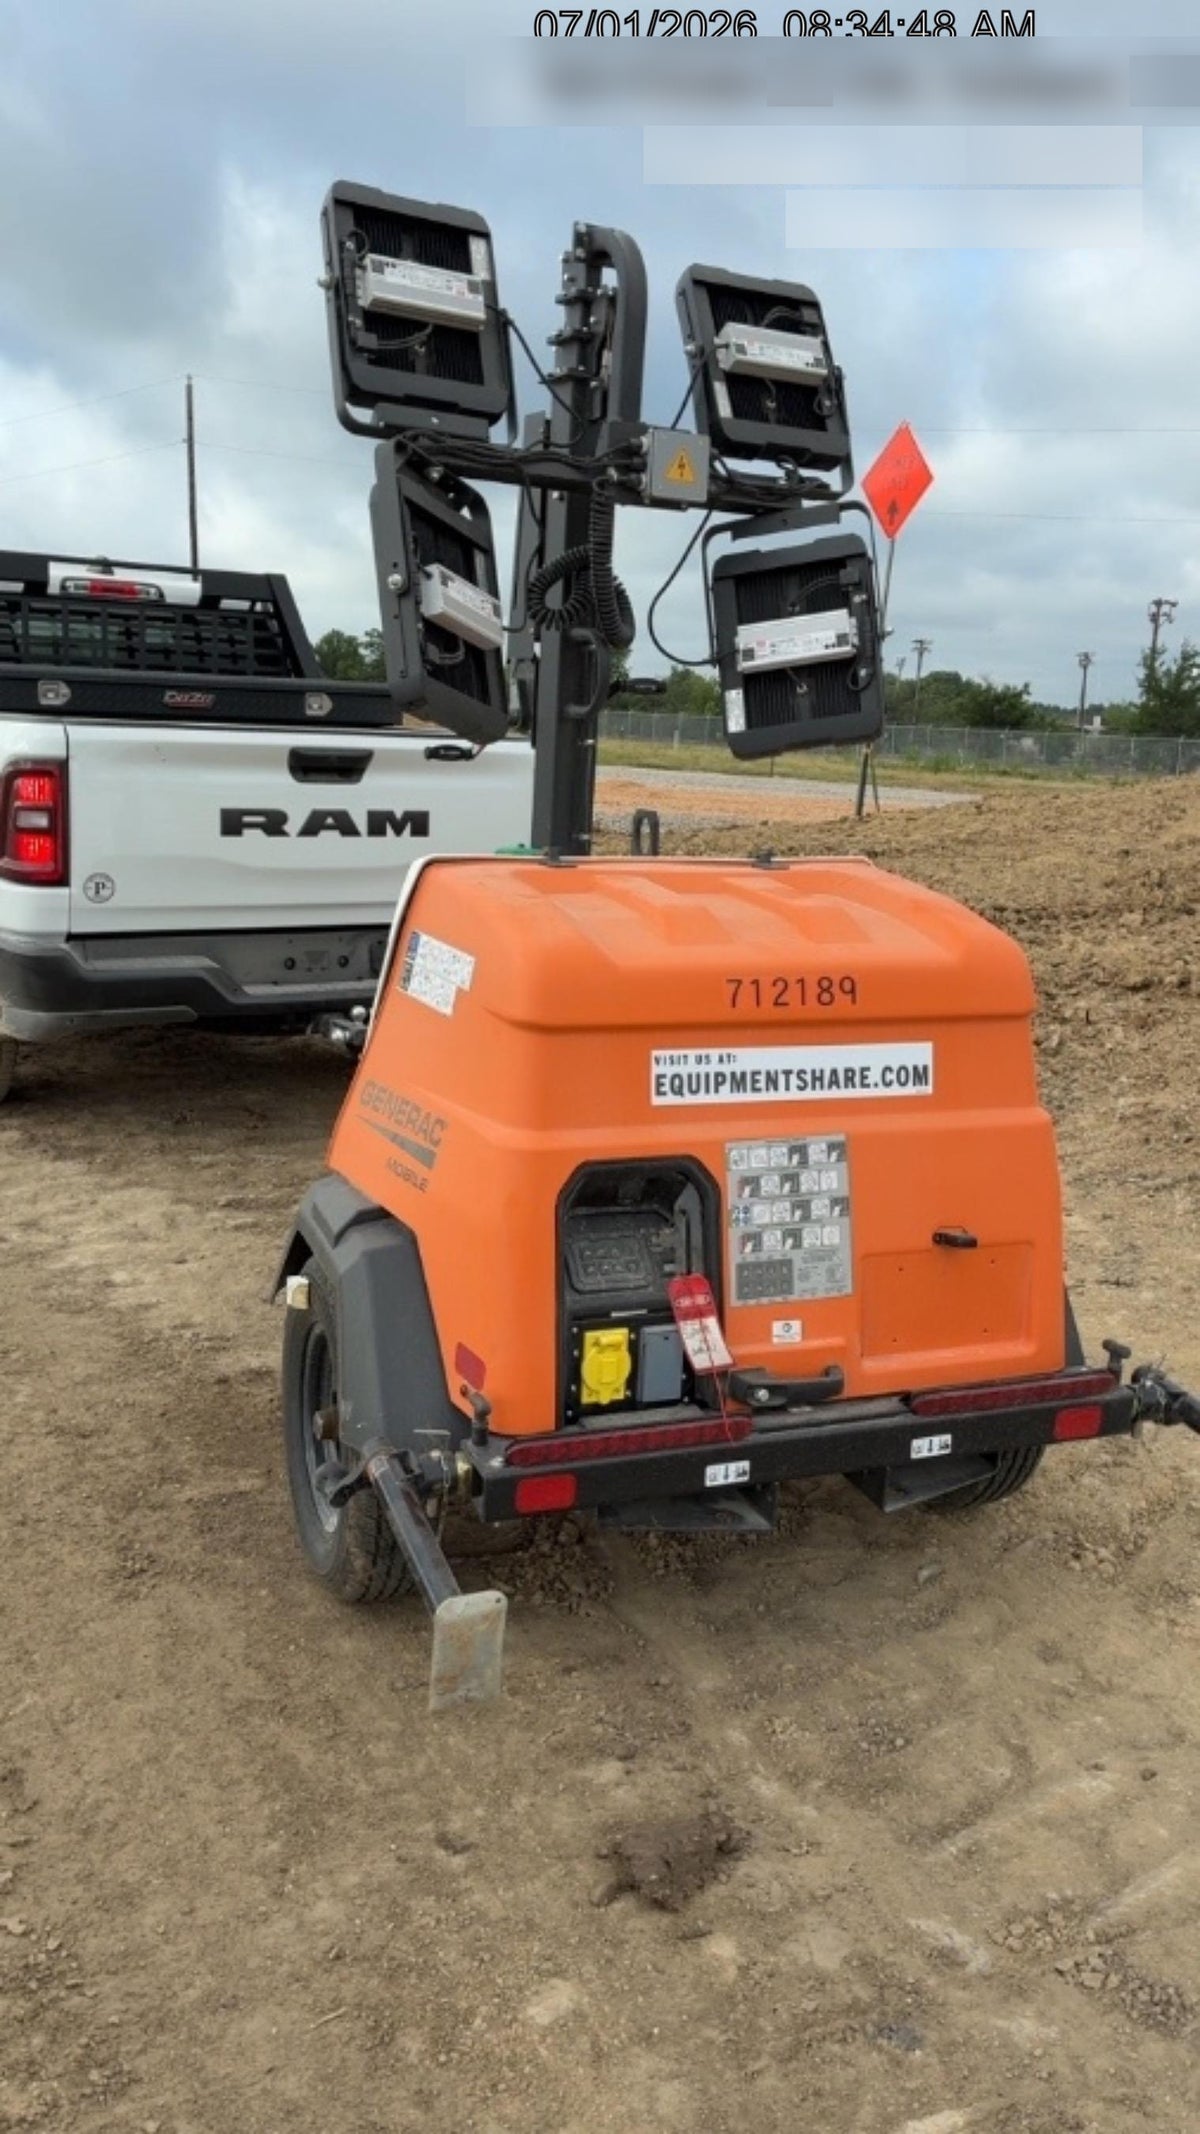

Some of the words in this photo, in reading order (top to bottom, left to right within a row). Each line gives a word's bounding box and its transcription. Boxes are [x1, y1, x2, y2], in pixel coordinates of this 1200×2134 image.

[220, 809, 430, 837] RAM
[726, 976, 858, 1008] 712189
[654, 1055, 690, 1066] VISIT
[695, 1054, 712, 1065] US
[717, 1053, 737, 1064] AT:
[654, 1065, 929, 1098] EQUIPMENTSHARE.COM
[359, 1080, 447, 1147] GENERAC
